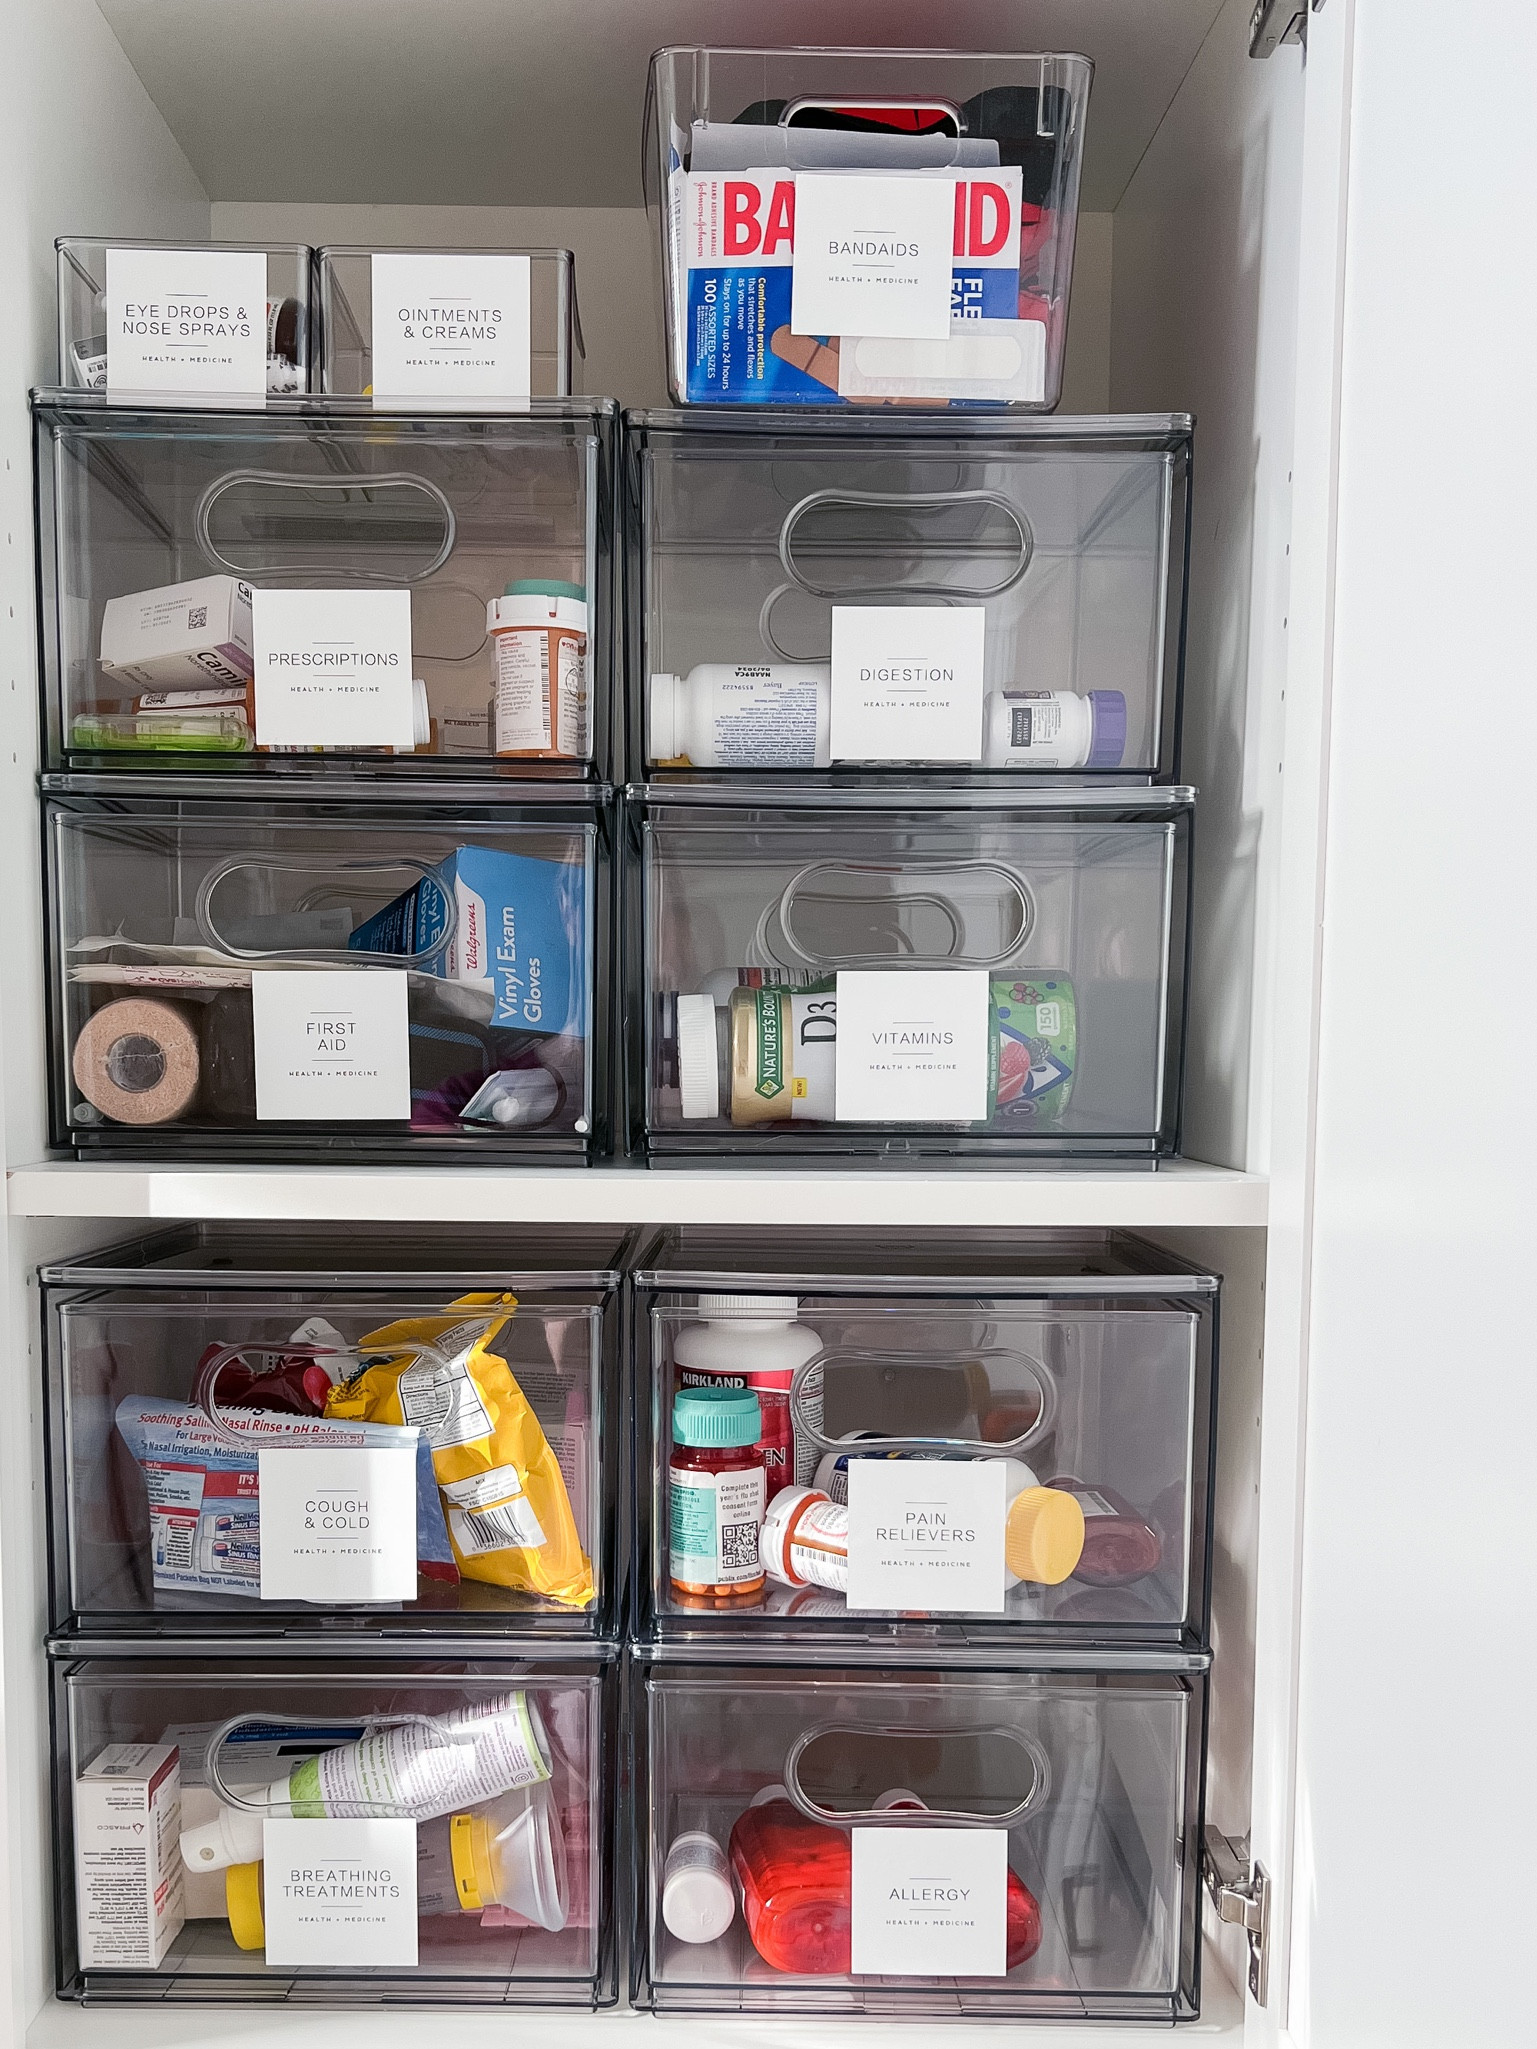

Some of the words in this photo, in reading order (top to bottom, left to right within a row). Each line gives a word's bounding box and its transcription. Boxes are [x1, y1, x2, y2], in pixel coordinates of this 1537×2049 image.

[830, 242, 918, 256] BANDAIDS
[723, 278, 732, 300] Stays
[738, 278, 745, 287] as
[748, 278, 756, 294] that
[704, 279, 717, 303] 100
[723, 302, 730, 313] on
[757, 277, 766, 332] Comfortable
[126, 304, 159, 317] EYE
[168, 306, 229, 319] DROPS
[237, 307, 247, 319] &
[399, 309, 501, 322] OINTMENTS
[747, 296, 756, 335] stretches
[723, 315, 731, 327] for
[123, 321, 171, 335] NOSE
[180, 323, 250, 337] SPRAYS
[404, 326, 414, 338] &
[422, 326, 496, 339] CREAMS
[708, 305, 717, 353] ASSORTED
[722, 329, 730, 340] up
[723, 342, 731, 351] to
[747, 336, 755, 352] and
[723, 353, 731, 365] 24
[756, 333, 765, 380] protection
[707, 354, 716, 379] SIZES
[747, 354, 755, 379] flexes
[722, 366, 730, 390] hours
[269, 653, 398, 665] PRESCRIPTIONS
[861, 669, 953, 681] DIGESTION
[466, 903, 481, 970] Walgreens
[497, 906, 516, 962] Exam
[497, 965, 524, 1020] Vinyl
[523, 957, 543, 1023] Gloves
[1040, 1007, 1052, 1031] 150
[307, 1023, 356, 1034] FIRST
[318, 1039, 346, 1050] AID
[872, 1033, 953, 1044] VITAMINS
[763, 1019, 777, 1078] NATURE'S
[682, 1372, 745, 1389] KIRKLAND
[137, 1412, 183, 1427] Soothing
[251, 1420, 282, 1433] Rinse
[175, 1430, 189, 1440] For
[189, 1431, 213, 1443] Large
[148, 1441, 171, 1453] Nasal
[171, 1443, 212, 1457] Irrigation,
[213, 1447, 259, 1460] Moisturizat
[238, 1474, 255, 1485] IT'S
[720, 1483, 749, 1493] Complete
[742, 1491, 750, 1499] flu
[306, 1501, 368, 1512] COUGH
[722, 1501, 745, 1511] consent
[733, 1510, 751, 1519] online
[906, 1513, 945, 1525] PAIN
[305, 1517, 315, 1528] &
[323, 1517, 369, 1529] COLD
[877, 1528, 975, 1541] RELIEVERS
[291, 1870, 390, 1881] BREATHING
[283, 1886, 399, 1897] TREATMENTS
[889, 1888, 970, 1900] ALLERGY
